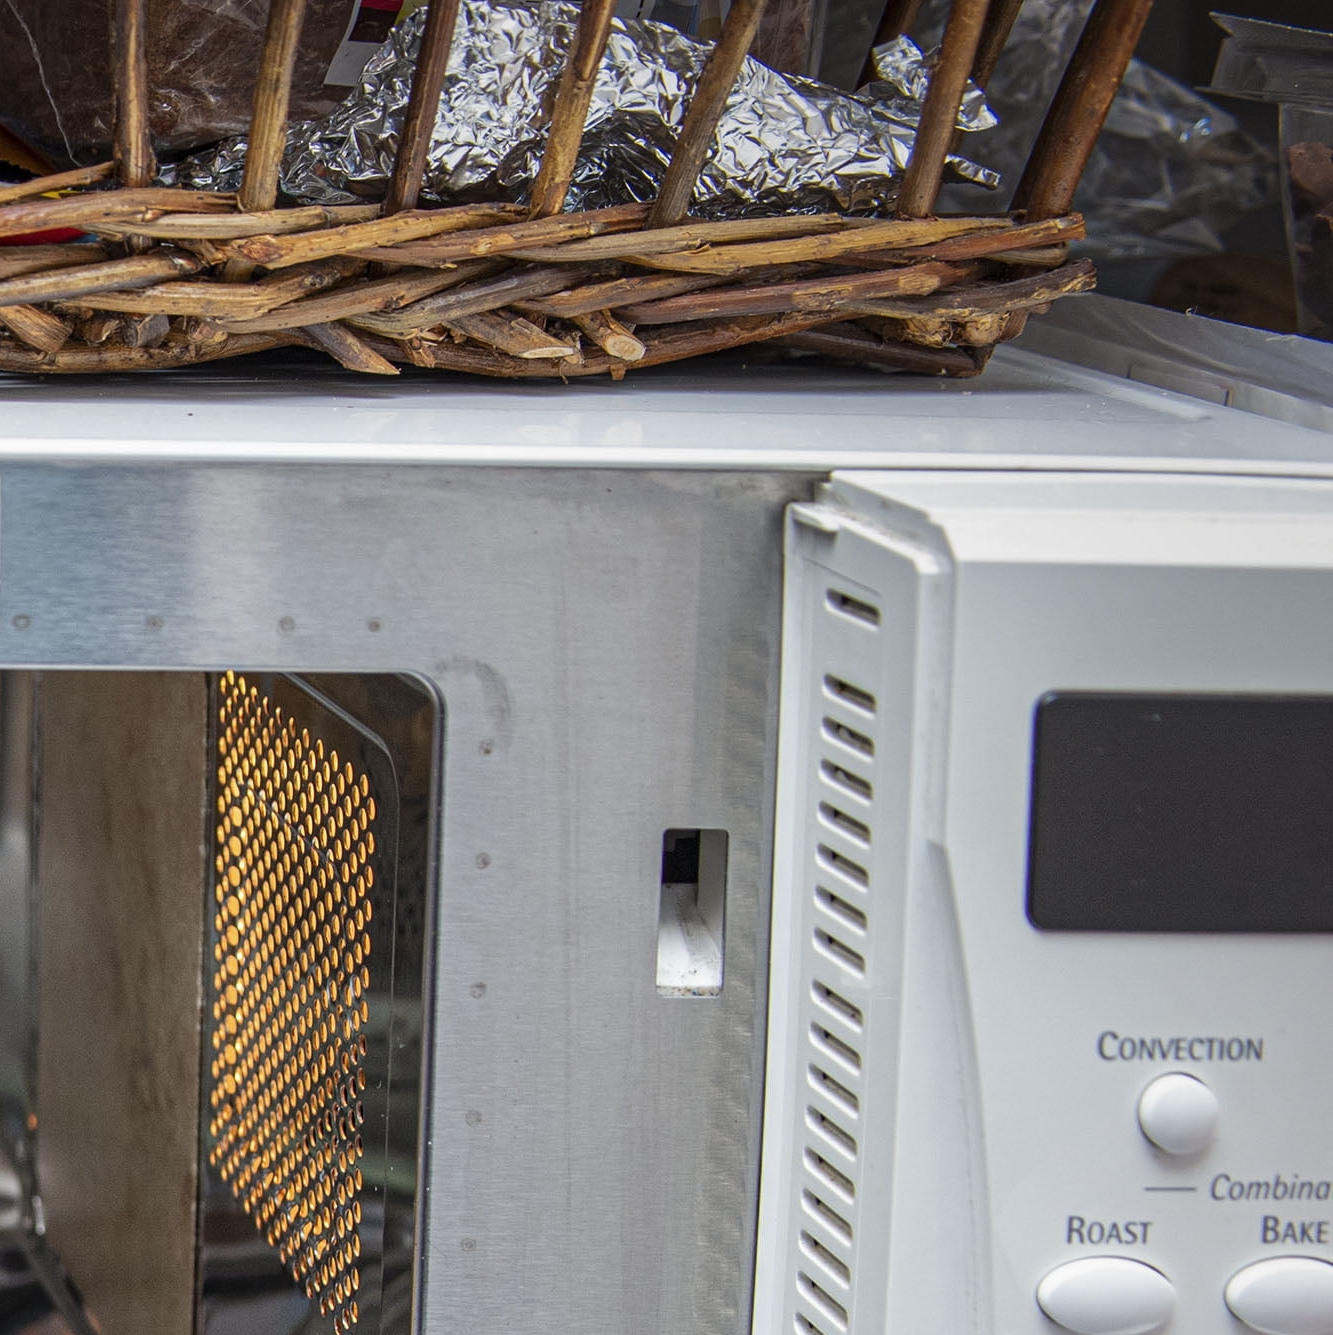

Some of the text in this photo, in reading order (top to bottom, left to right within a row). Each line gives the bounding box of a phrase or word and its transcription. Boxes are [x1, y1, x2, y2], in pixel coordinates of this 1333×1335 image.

[1096, 1031, 1264, 1061] CONVECTION
[1066, 1215, 1151, 1245] ROAST
[1261, 1215, 1330, 1244] BAKE
